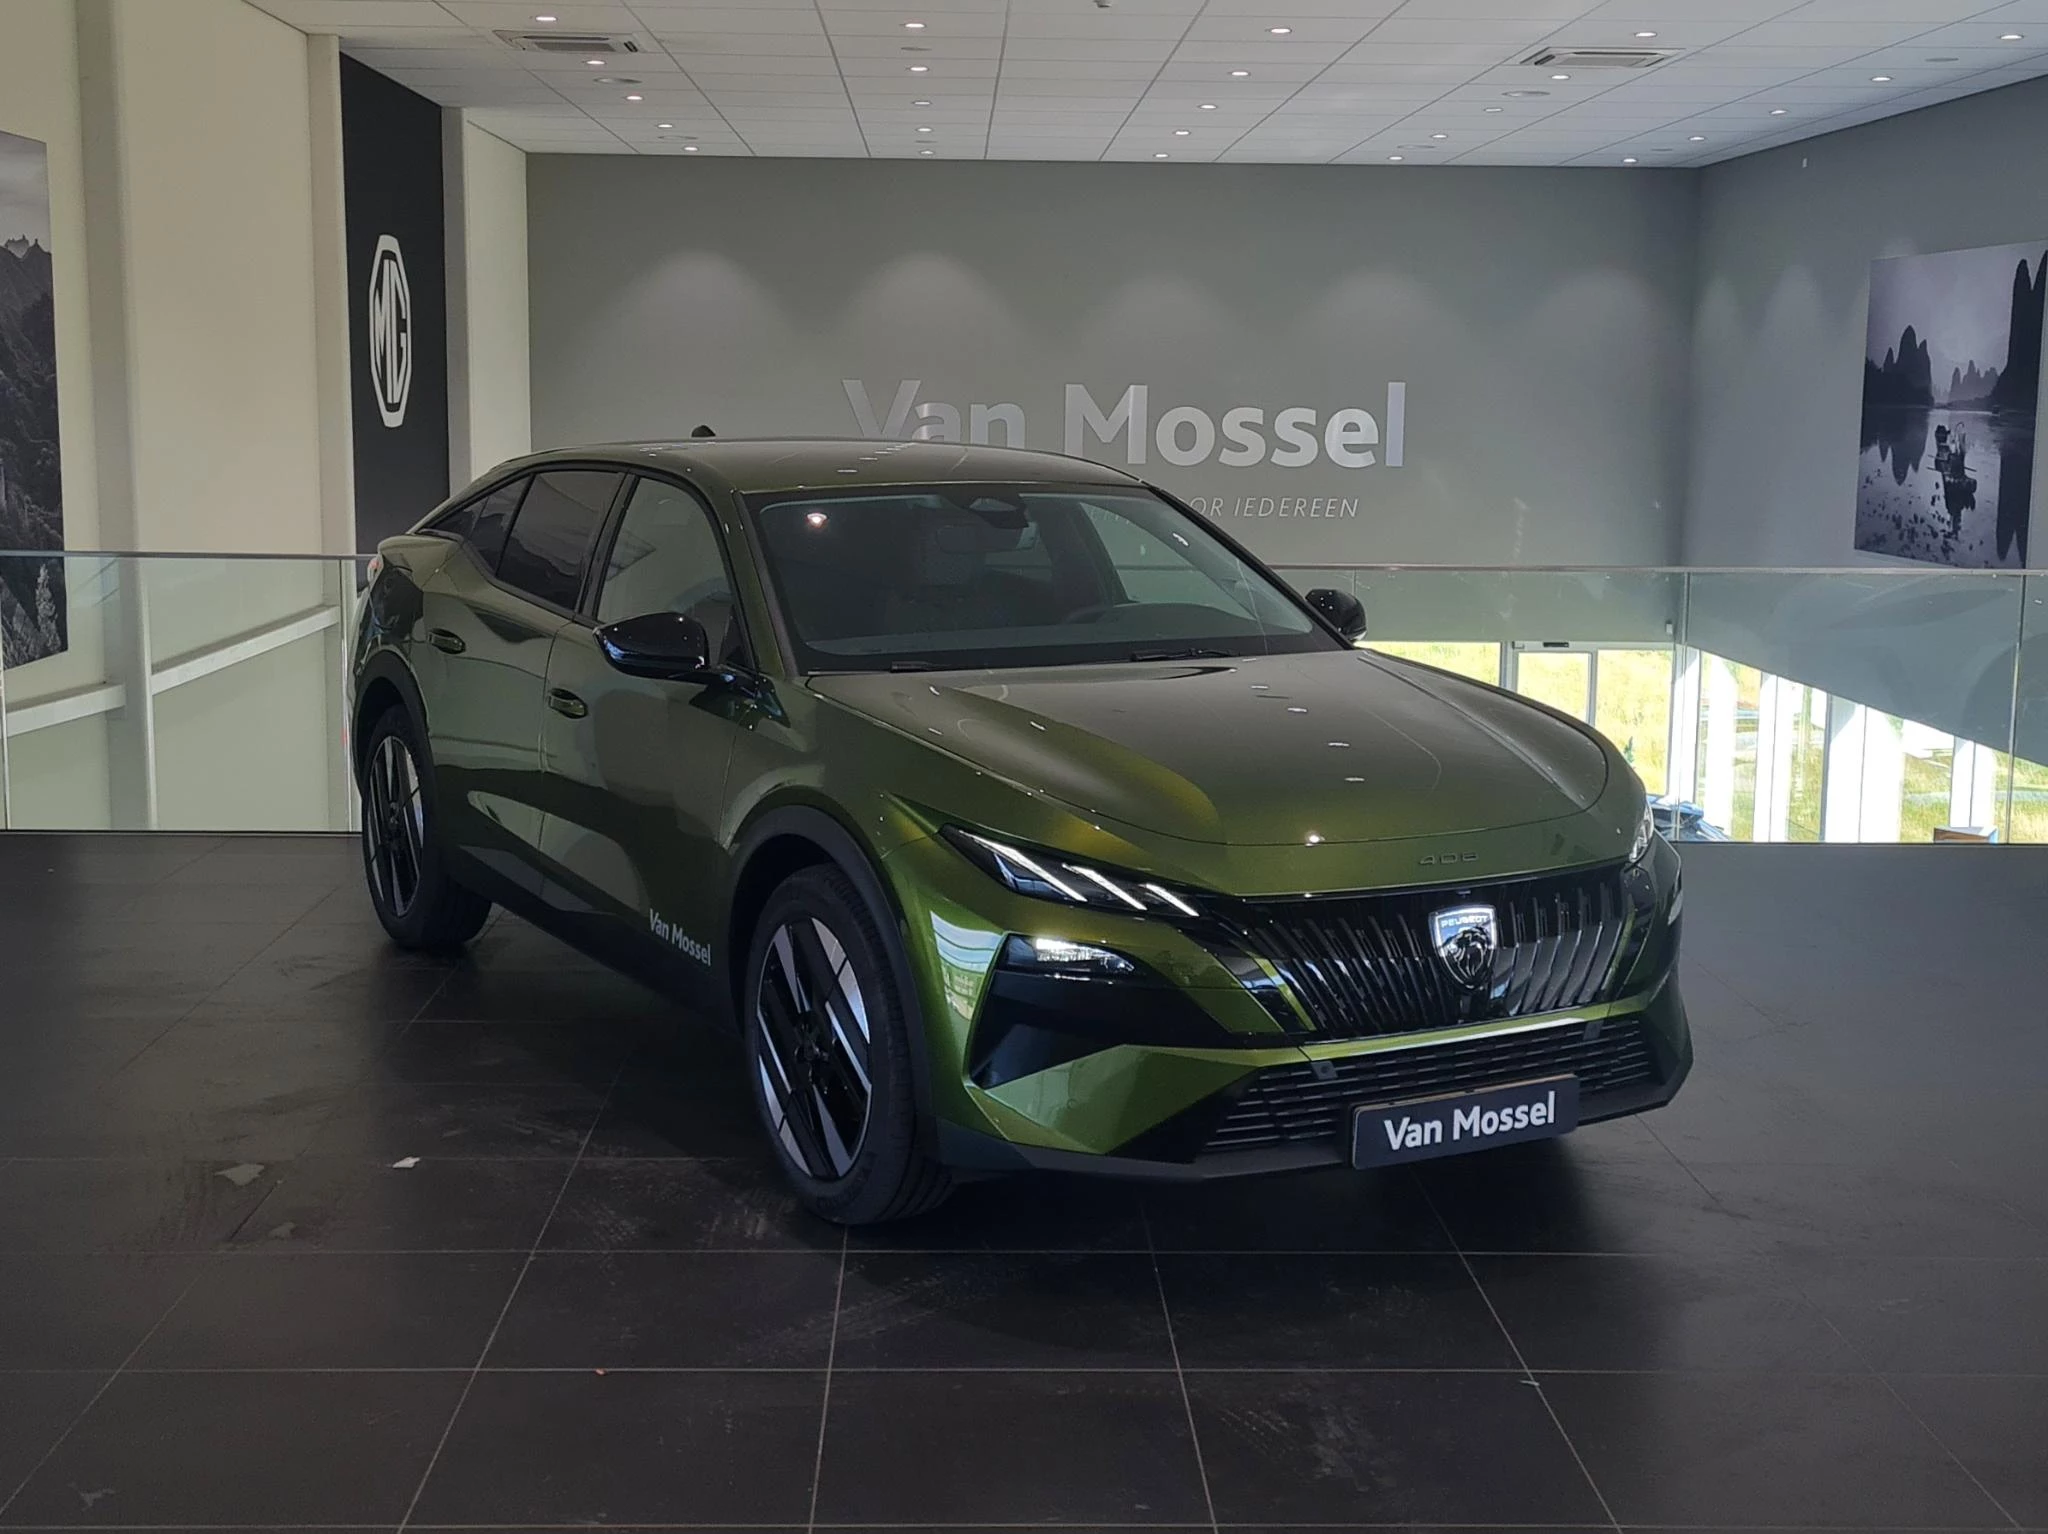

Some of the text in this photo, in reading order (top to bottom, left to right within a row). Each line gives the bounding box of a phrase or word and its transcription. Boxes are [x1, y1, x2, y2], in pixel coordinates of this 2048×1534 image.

[373, 256, 408, 405] MG
[842, 379, 1407, 468] Van Mossel
[1190, 497, 1360, 518] OR IEDEREEN
[649, 907, 712, 967] Van Mossel
[1440, 915, 1489, 929] PEUGEOT
[1384, 1090, 1556, 1150] Van Mossel
